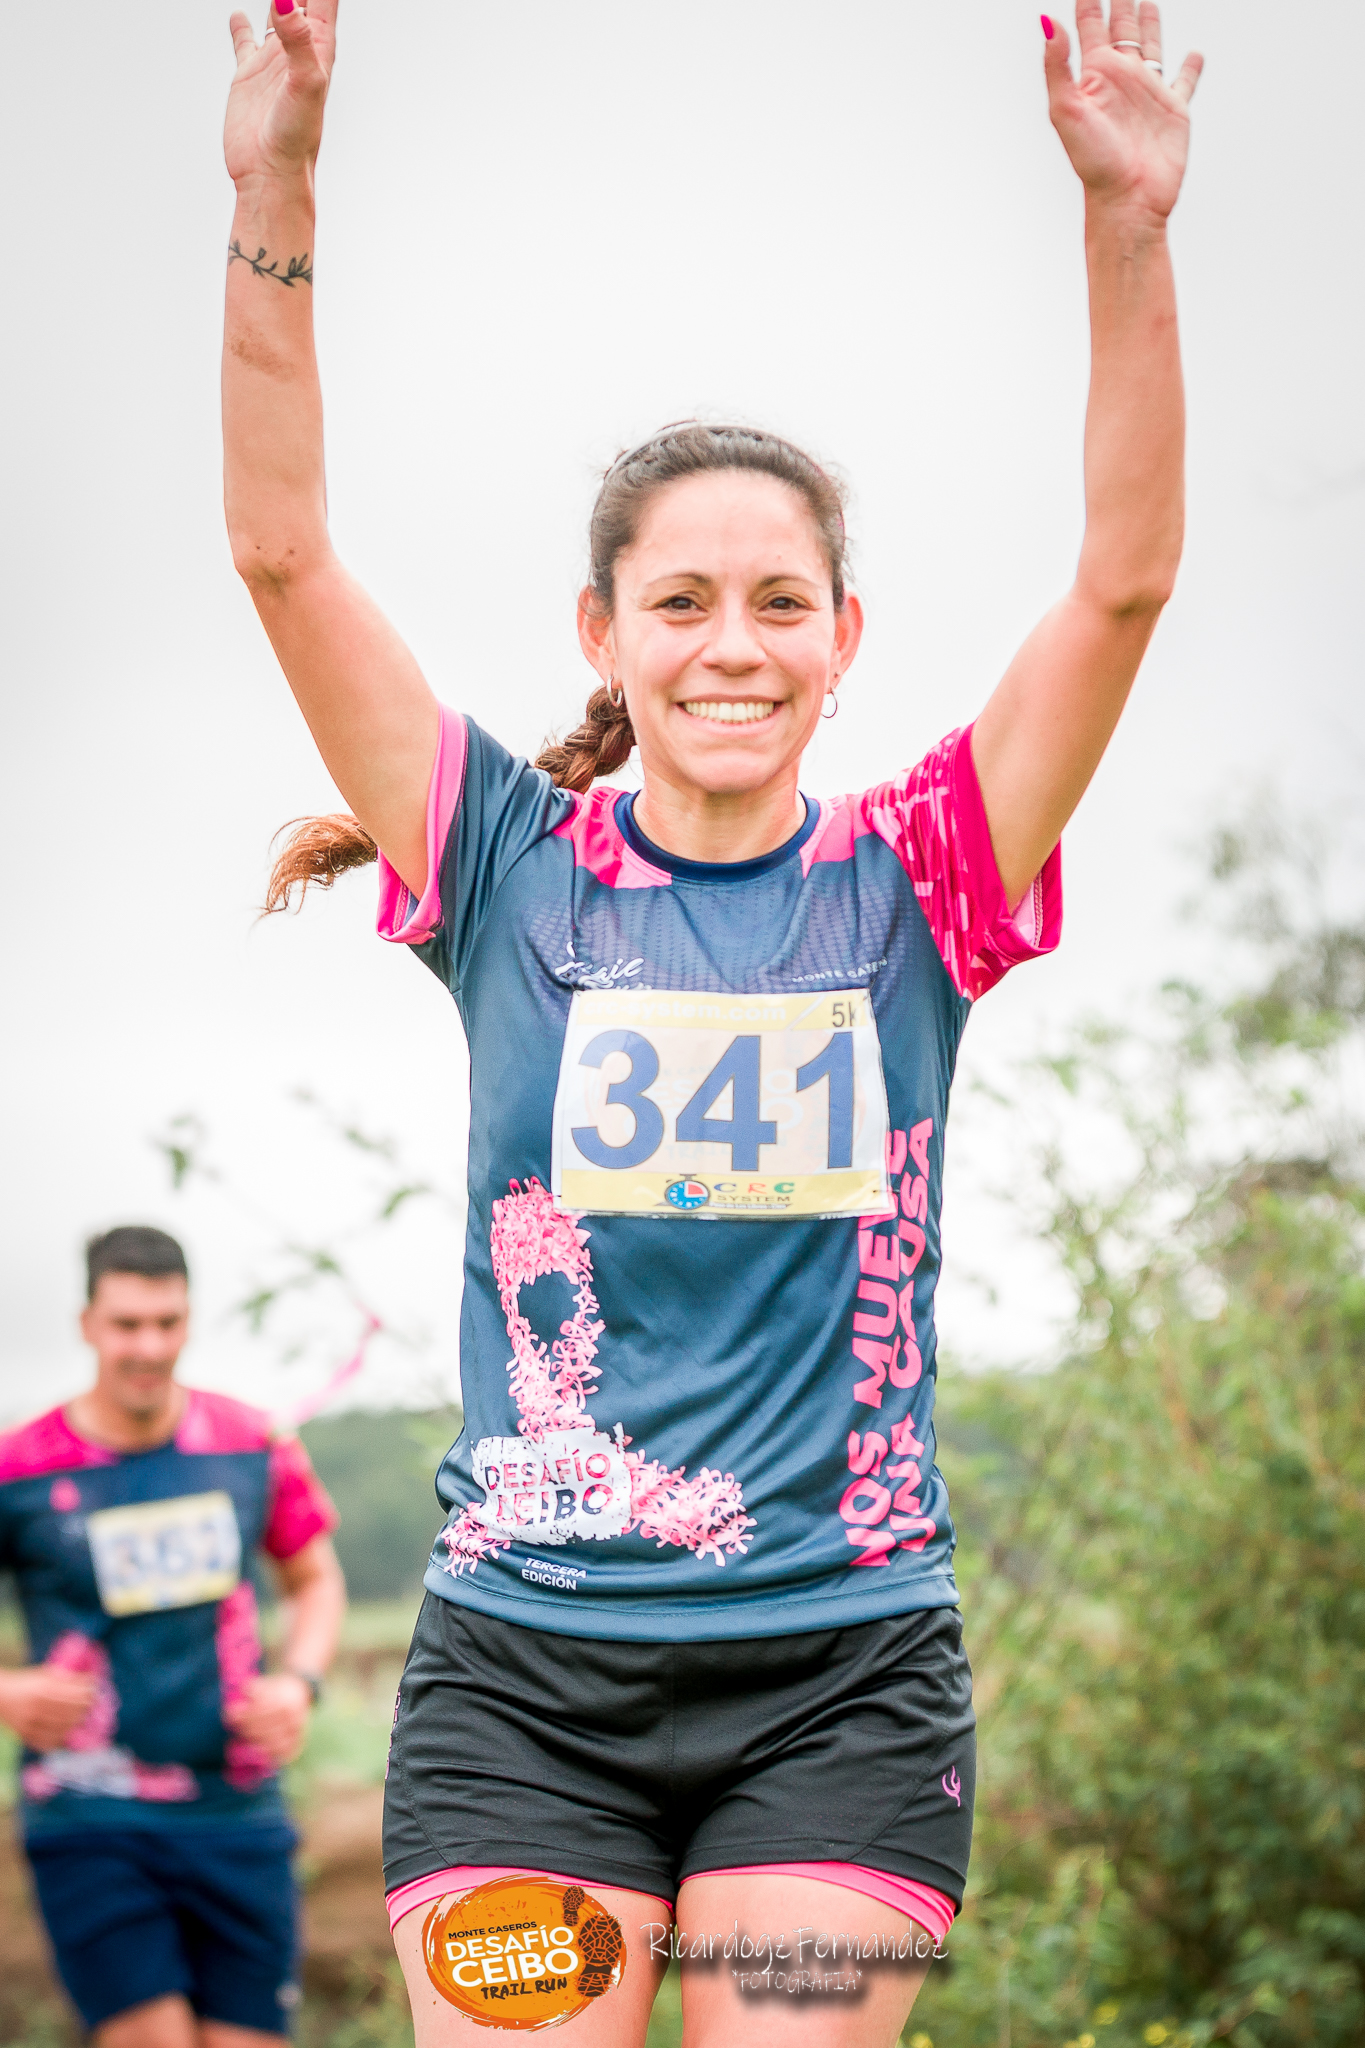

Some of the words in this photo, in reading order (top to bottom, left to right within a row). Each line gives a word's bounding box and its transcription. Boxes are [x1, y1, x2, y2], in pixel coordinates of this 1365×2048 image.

[570, 1029, 855, 1172] 341
[713, 1182, 796, 1195] CRC
[717, 1195, 791, 1203] SYSTEM
[888, 1116, 934, 1390] CAUSA
[839, 1429, 898, 1567] NOS
[886, 1412, 937, 1554] UNA
[521, 1568, 578, 1591] EDICIÓN
[525, 1557, 588, 1580] TERCERA
